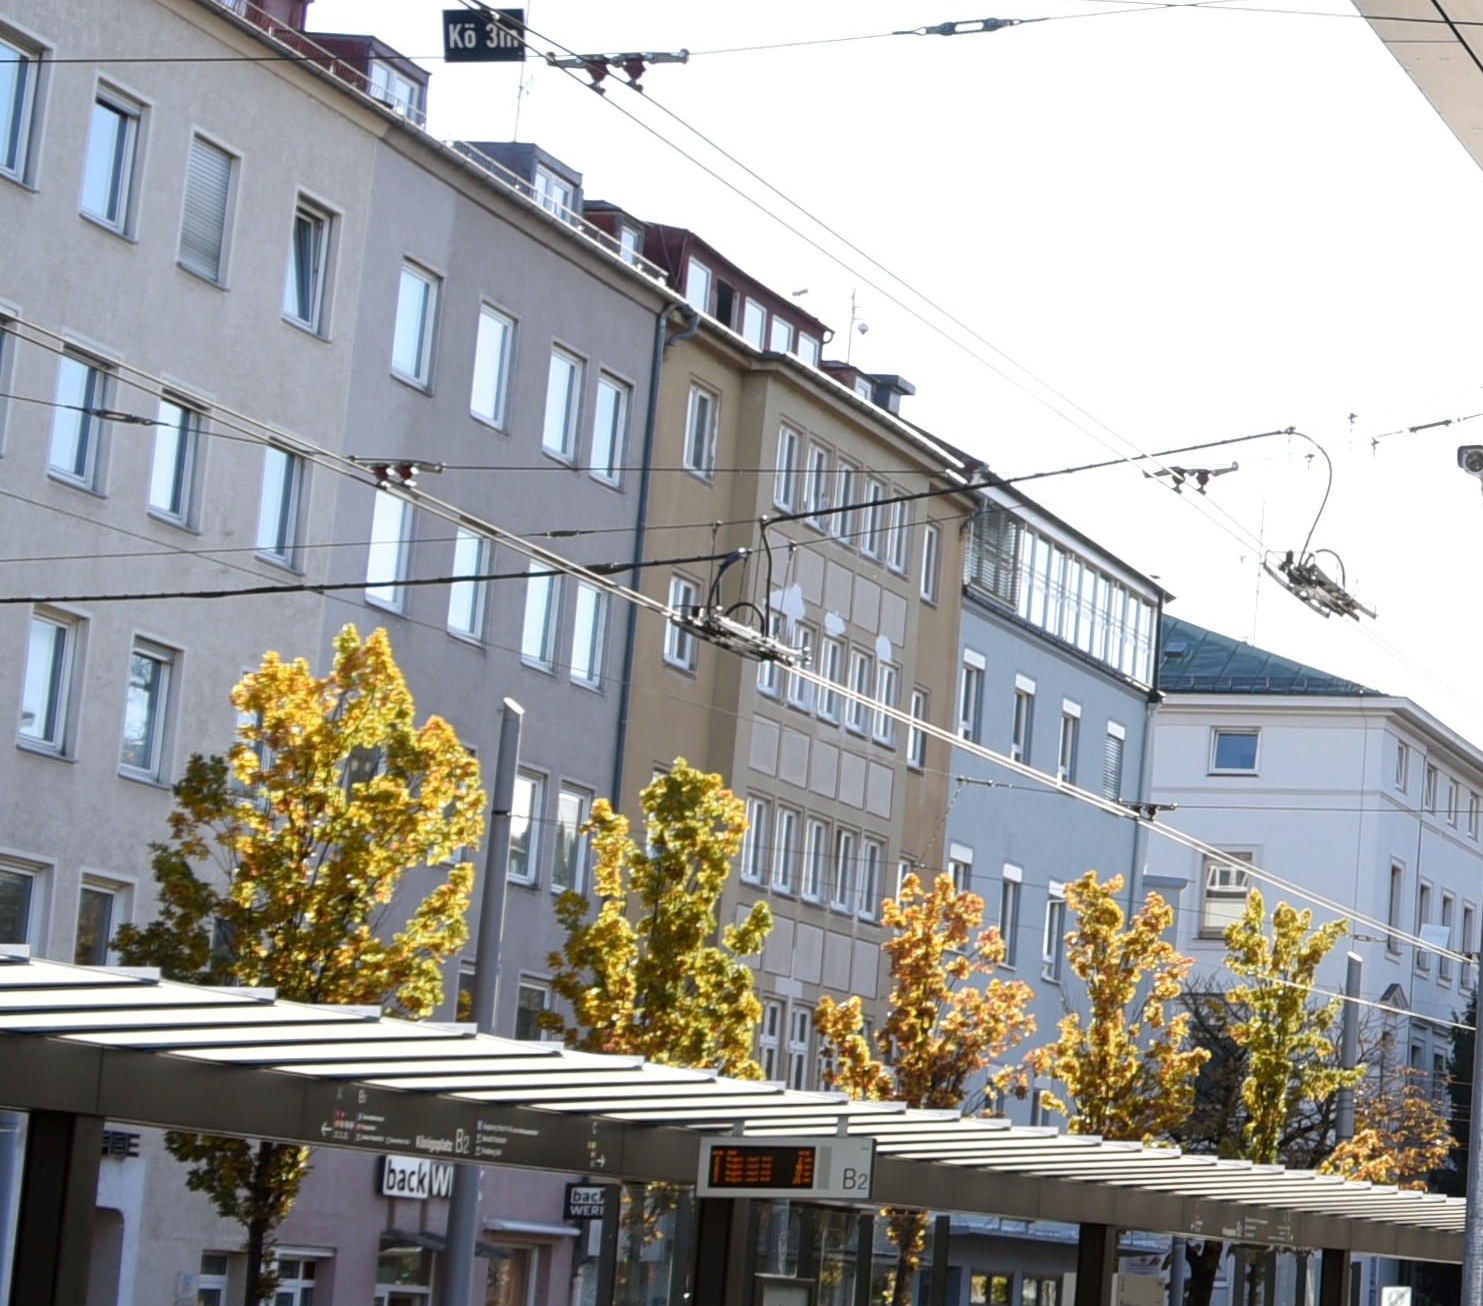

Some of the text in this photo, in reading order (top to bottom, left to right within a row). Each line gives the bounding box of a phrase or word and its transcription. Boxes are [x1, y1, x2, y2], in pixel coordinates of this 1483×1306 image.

[449, 23, 476, 48] Kö
[456, 1128, 470, 1154] B2
[842, 1168, 868, 1190] B2
